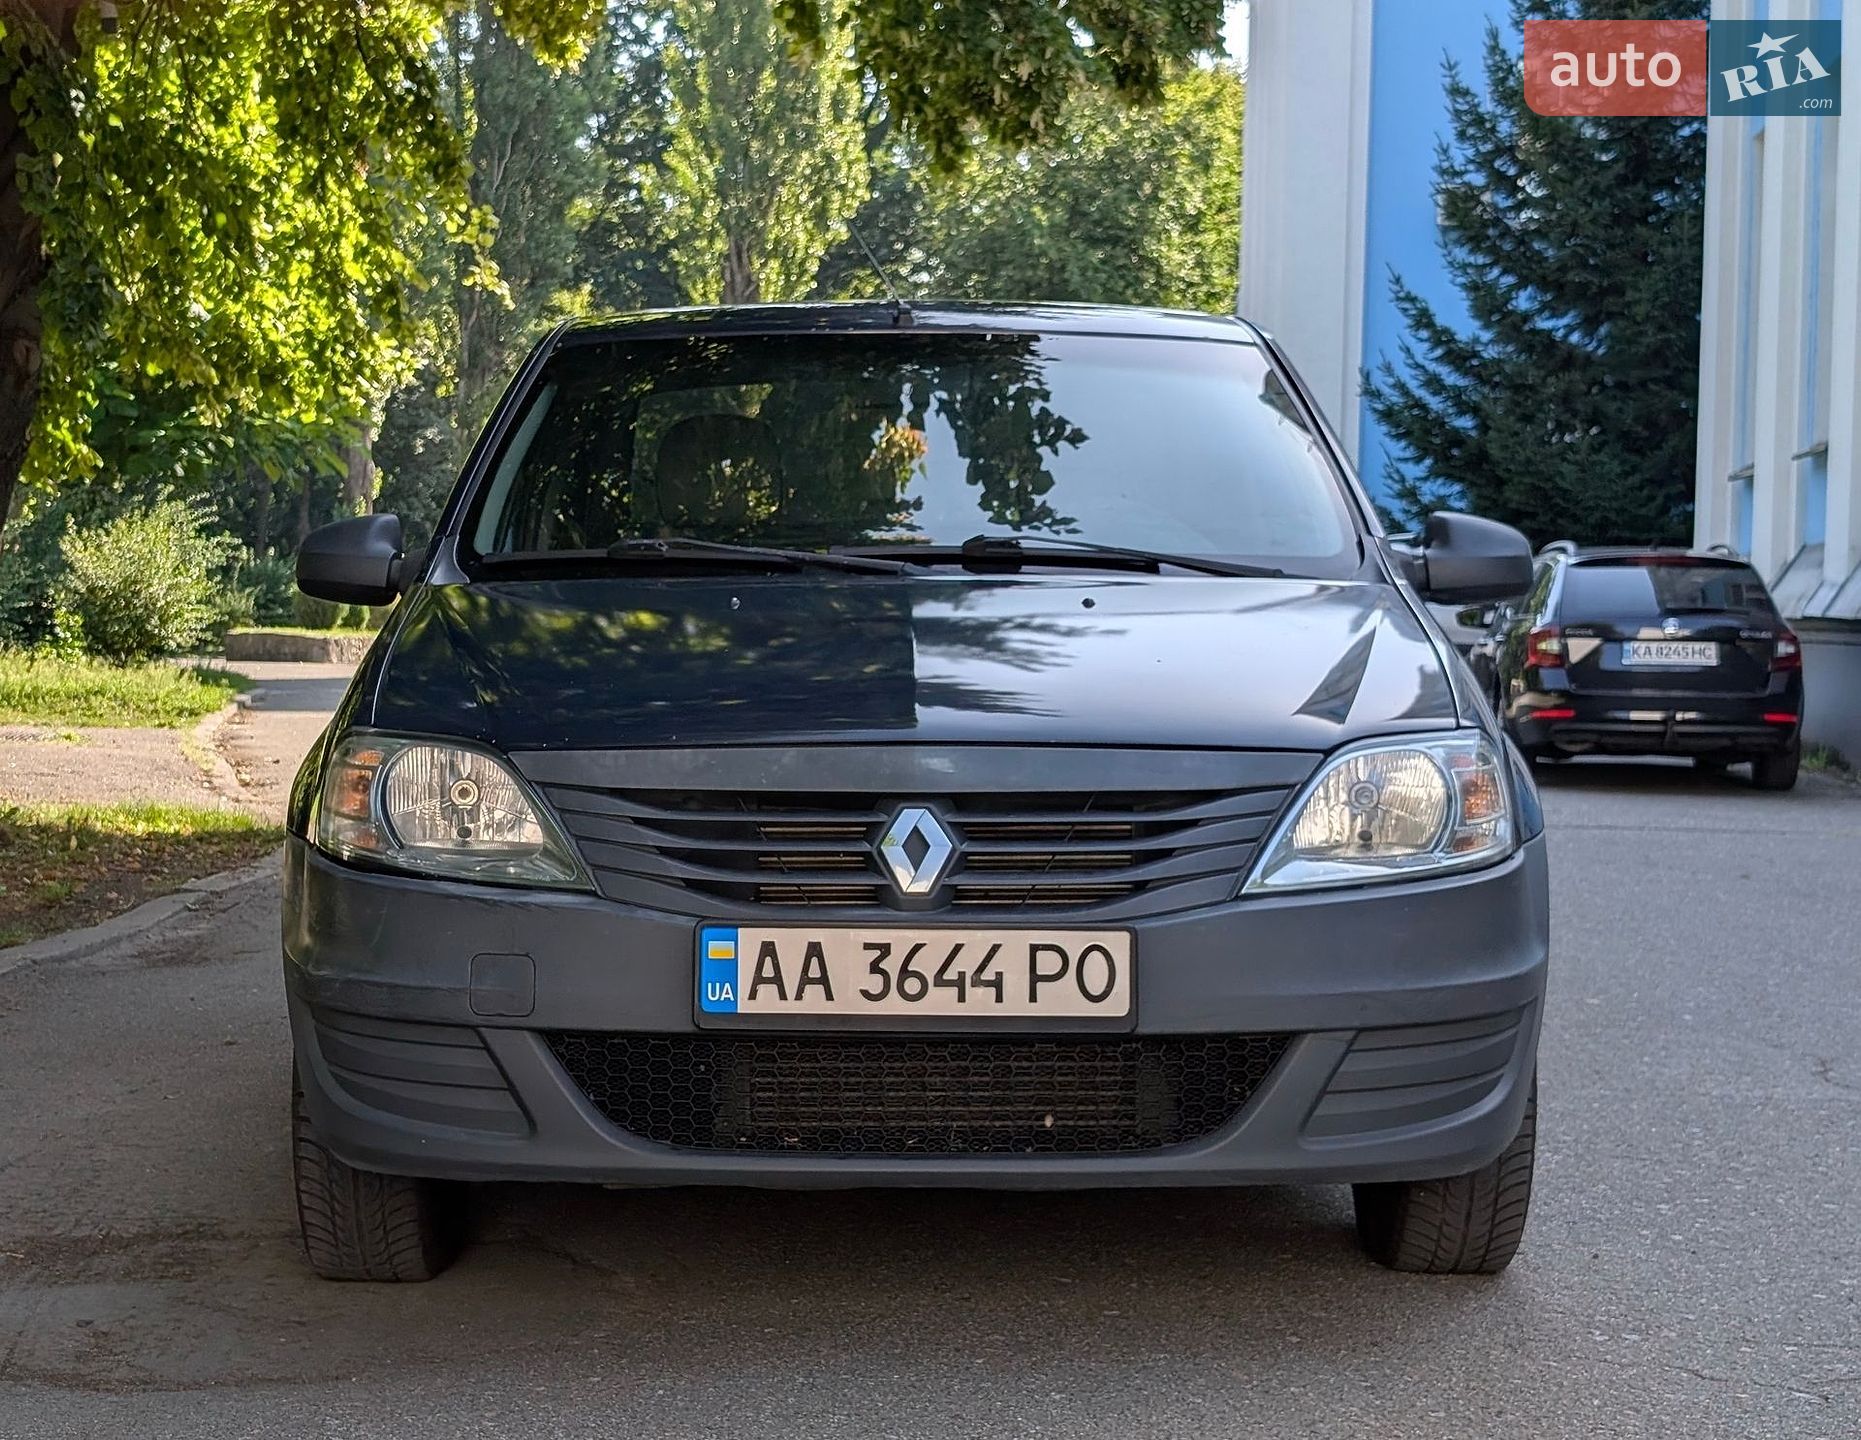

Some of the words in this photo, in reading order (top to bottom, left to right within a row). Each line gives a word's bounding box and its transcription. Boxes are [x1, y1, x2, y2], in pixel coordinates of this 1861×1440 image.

[1632, 645, 1652, 659] KA
[1691, 645, 1713, 660] HC
[748, 940, 834, 1001] AA
[859, 942, 1004, 1003] 3644
[1028, 943, 1117, 1003] PO
[708, 982, 735, 1001] UA
